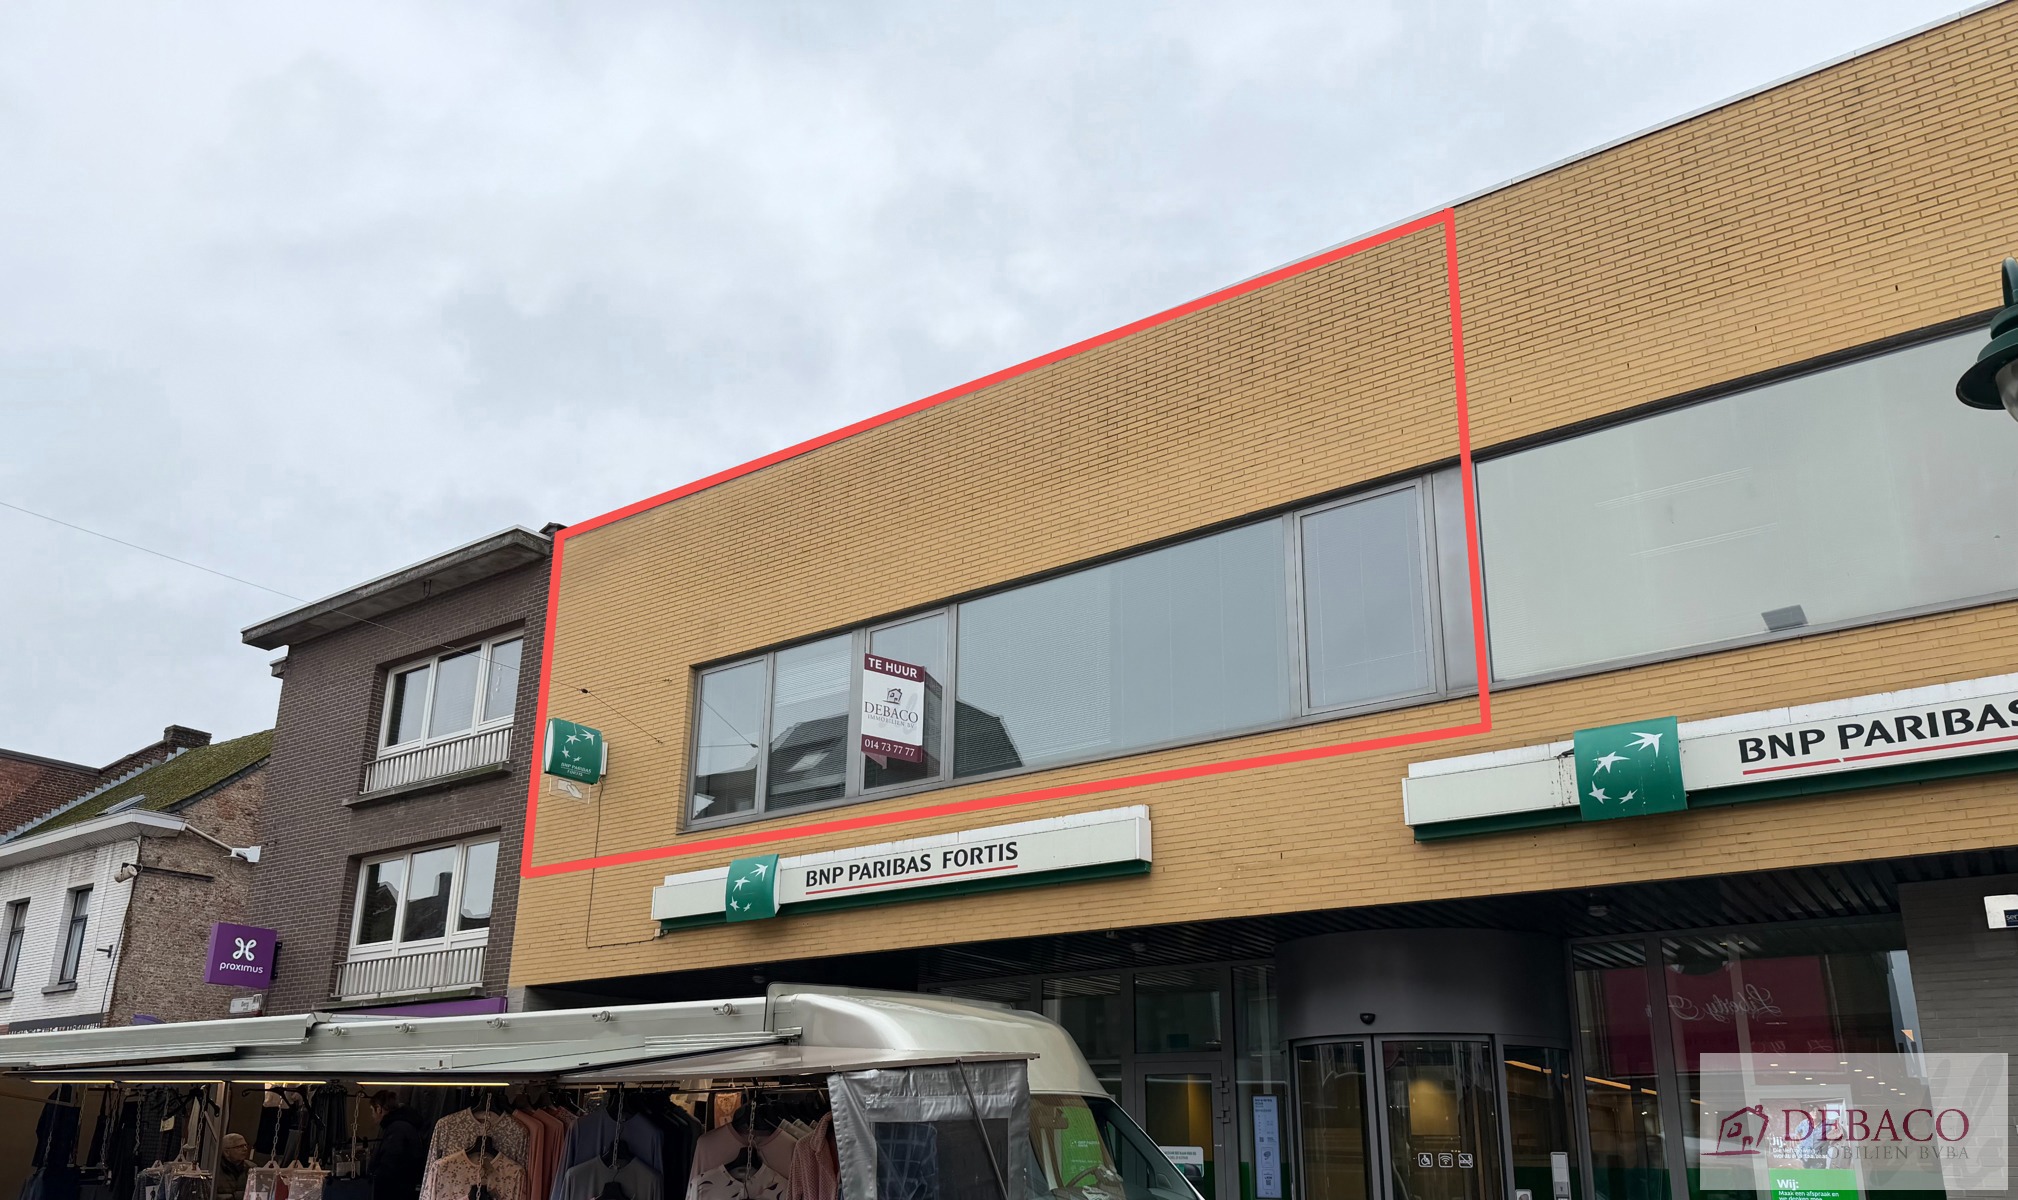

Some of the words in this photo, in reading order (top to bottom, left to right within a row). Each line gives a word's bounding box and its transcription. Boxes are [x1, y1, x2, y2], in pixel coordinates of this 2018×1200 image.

[868, 658, 882, 669] TE
[886, 662, 917, 678] HUUR
[864, 701, 919, 724] DEBACO
[868, 715, 904, 727] IMMOBILIEN
[864, 738, 879, 750] 014
[881, 742, 892, 752] 73
[893, 744, 903, 754] 77
[905, 747, 915, 757] 77
[1738, 728, 1826, 764] BNP
[805, 866, 844, 888] BNP
[848, 853, 932, 882] PARIBAS
[941, 841, 1019, 869] FORTIS
[219, 962, 264, 974] proximus
[1776, 1179, 1800, 1191] Wij:
